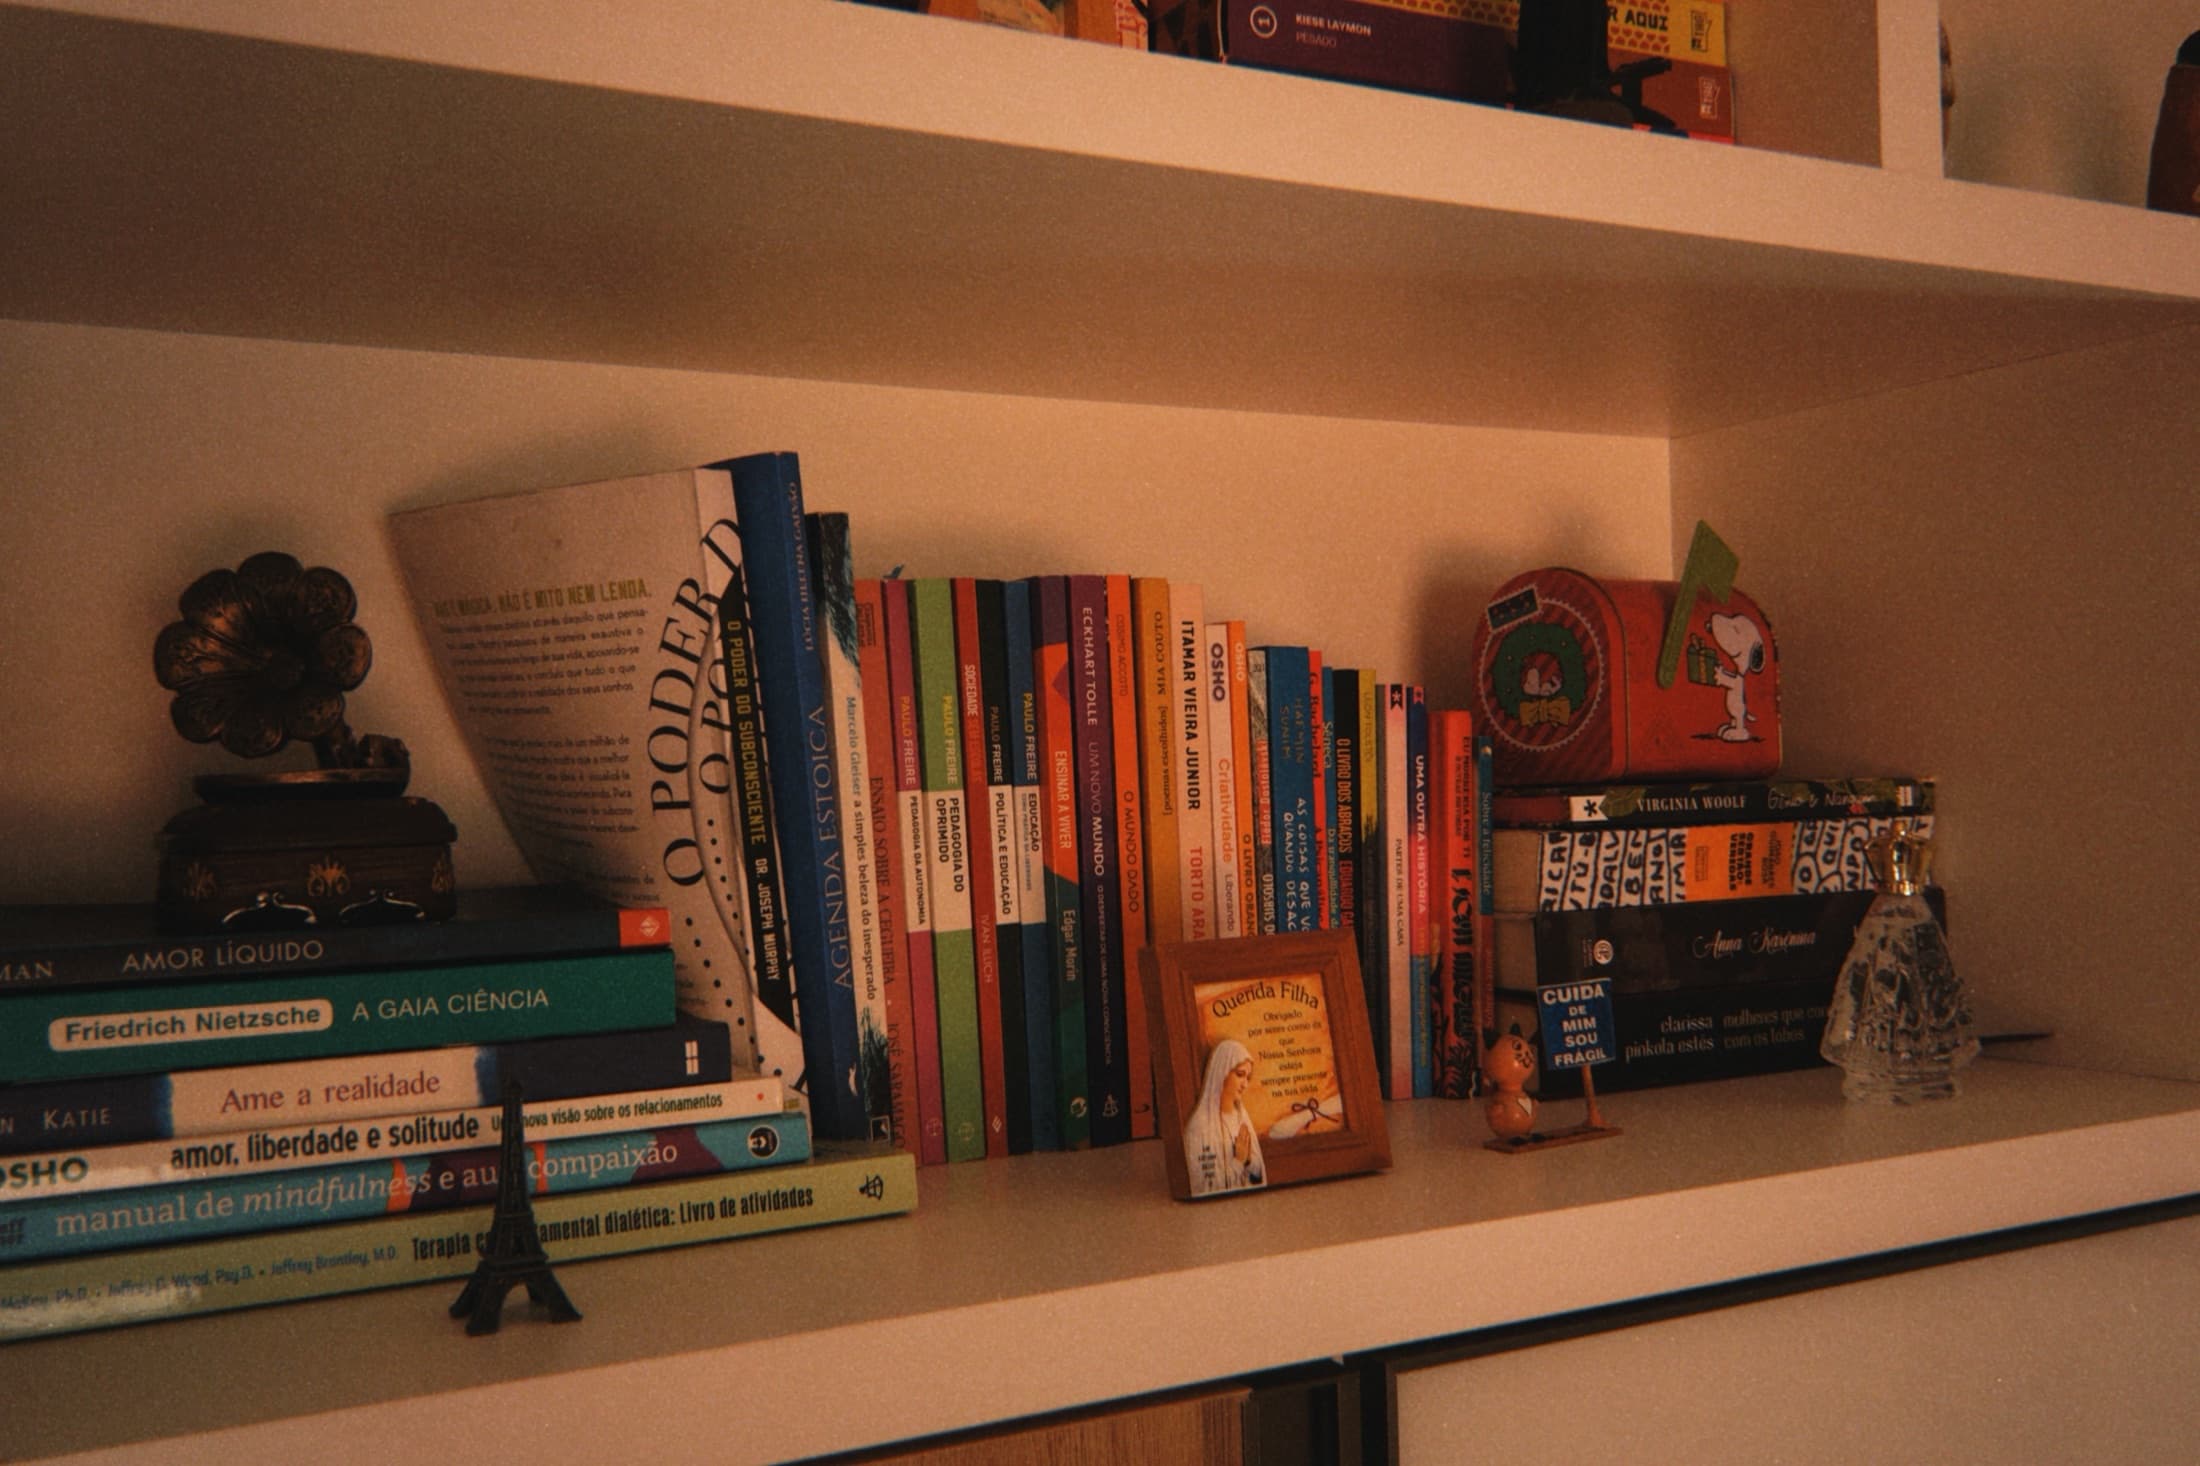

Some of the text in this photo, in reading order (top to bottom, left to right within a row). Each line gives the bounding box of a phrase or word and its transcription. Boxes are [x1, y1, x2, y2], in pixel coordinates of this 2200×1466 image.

[1296, 13, 1371, 37] KIESE LAYMON
[1296, 31, 1337, 48] PESADO
[1625, 10, 1668, 31] AQUI
[535, 578, 652, 609] MITO NEM LENDA.
[1082, 607, 1098, 726] ECKHART TOLLE
[1154, 611, 1167, 696] MIA COUTO
[1211, 643, 1226, 702] OSHO
[1235, 642, 1245, 681] OSHO
[964, 664, 979, 717] SOCIEDADE
[1181, 620, 1200, 810] ITAMAR VIEIRA JUNIOR
[846, 697, 859, 748] Marcelo
[901, 696, 916, 785] PAULO FREIRE
[942, 695, 957, 785] PAULO FREIRE
[990, 706, 1003, 783] PAULO FREIRE
[1022, 692, 1037, 781] PAULO FREIRE
[1322, 720, 1334, 769] Sêneca
[1336, 738, 1351, 746] O
[849, 750, 862, 797] Gleiser
[1337, 748, 1352, 779] LIVRO
[1415, 754, 1425, 789] UMA
[727, 620, 780, 981] O PODER DO SUBCONSCIENTE DR. JOSEPH MURPHY
[1055, 751, 1072, 849] ENSINAR A VIVER
[1088, 742, 1105, 876] UM NOVO MUNDO
[1161, 768, 1173, 816] [poemas
[1338, 781, 1352, 803] DOS
[1638, 795, 1746, 812] VIRGINIA WOOLF
[853, 810, 866, 862] simples
[935, 798, 950, 863] OPRIMIDO
[1028, 793, 1041, 852] EDUCAÇÃO
[1337, 805, 1353, 854] ABRAÇOS
[1416, 791, 1427, 843] OUTRA
[663, 838, 704, 886] O
[808, 706, 852, 990] AGENDA ESTOICA
[909, 795, 926, 925] PEDAGOGIA DA AUTONOMIA
[949, 797, 965, 893] PEDAGOGIA DO
[995, 793, 1014, 915] POLÍTICA E EDUCAÇÃO
[1123, 790, 1140, 913] O MUNDO DADO
[1217, 759, 1236, 932] Criatividade Liberando
[1243, 834, 1254, 888] O LIVRO
[1283, 812, 1295, 873] QUANDO
[1297, 798, 1312, 910] AS COISAS QUE
[1481, 791, 1493, 896] Sobre felicidade
[1729, 833, 1738, 891] VEREDAS
[1745, 832, 1754, 885] GRANDE
[856, 864, 871, 904] beleza
[871, 776, 895, 986] ENSAIO SOBRE A CEGUEIRA
[1190, 847, 1204, 902] TORTO
[1262, 873, 1276, 922] SUBSOLO
[1416, 846, 1429, 914] HISTÓRIA
[860, 906, 870, 926] do
[981, 915, 992, 944] IVAN
[121, 939, 324, 974] AMOR LÍQUIDO
[862, 929, 876, 1001] inesperado
[1060, 909, 1079, 981] Edgar Morin
[1692, 928, 1742, 960] Anna
[351, 986, 549, 1022] A GAIA CIÊNCIA
[1212, 980, 1320, 1019] Querida Filha
[1263, 1009, 1303, 1022] Obrigado
[1543, 983, 1605, 1005] CUIDA
[1569, 1005, 1587, 1016] DE
[65, 1005, 321, 1042] Friedrich Nietzsche
[1248, 1022, 1309, 1038] por como
[1279, 1037, 1295, 1046] que
[1562, 1017, 1597, 1033] MIM
[1565, 1032, 1598, 1048] SOU
[1660, 1015, 1713, 1034] clarissa
[1258, 1045, 1321, 1060] Nossa Senhora
[1554, 1048, 1607, 1067] FRÁGIL
[1625, 1039, 1675, 1064] pinkola
[220, 1071, 441, 1114] Ame a realidade
[886, 1022, 906, 1150] JOSÉ SARAMAGO
[1261, 1070, 1328, 1087] sempre presente
[1300, 1084, 1318, 1094] vida
[43, 1106, 112, 1130] KATIE
[551, 1105, 581, 1124] visão
[584, 1101, 614, 1122] sobre
[618, 1103, 631, 1118] os
[634, 1093, 723, 1116] relacionamentos
[247, 1125, 358, 1164] liberdade
[367, 1128, 381, 1146] e
[389, 1113, 479, 1146] solitude
[55, 1195, 189, 1238] manual
[194, 1190, 233, 1220] de
[242, 1171, 431, 1215] mindfulness
[439, 1171, 455, 1190] e
[412, 1185, 814, 1262] Terapia dialética: Livro de atividades
